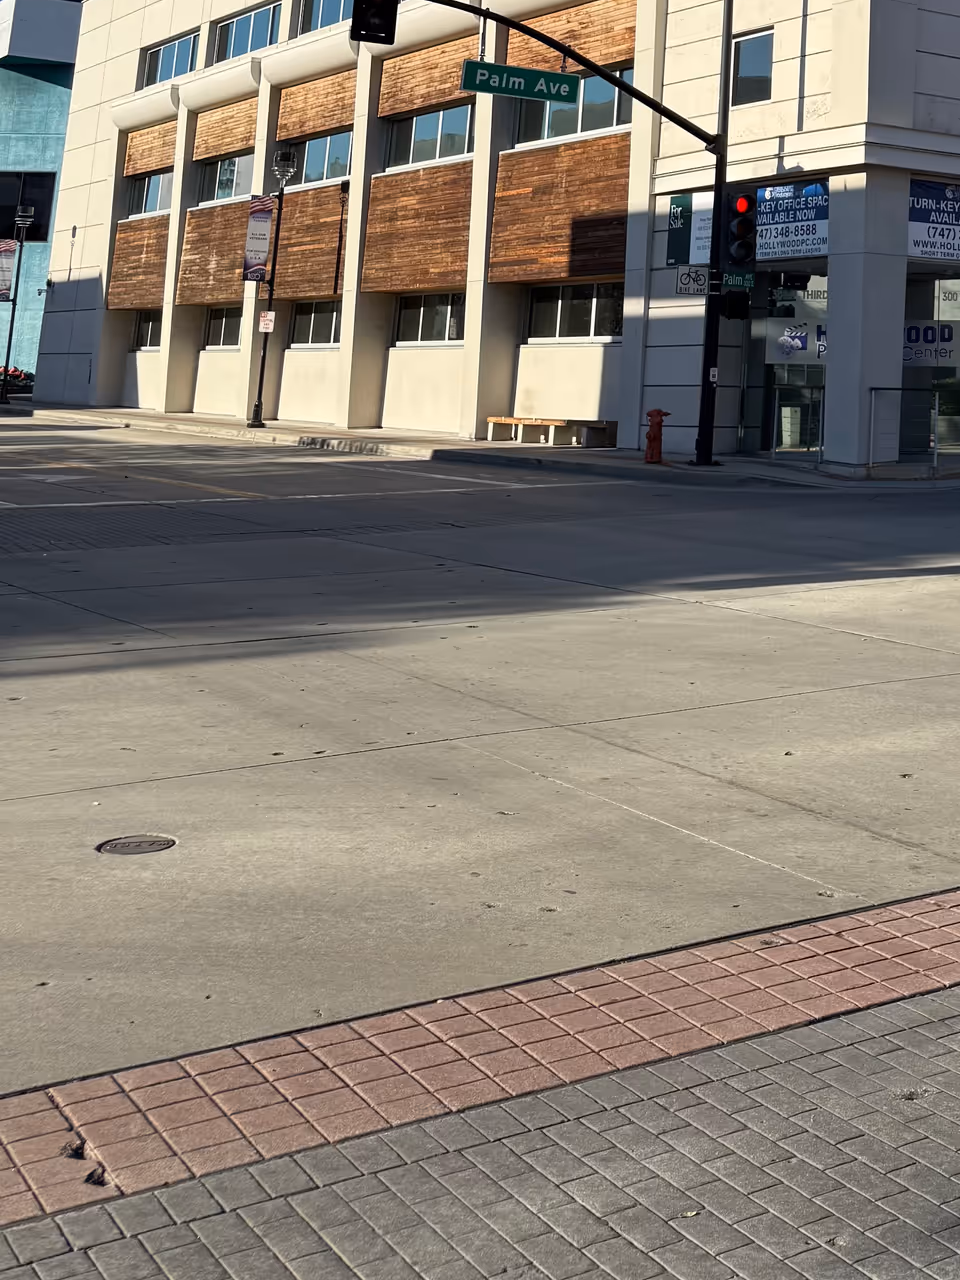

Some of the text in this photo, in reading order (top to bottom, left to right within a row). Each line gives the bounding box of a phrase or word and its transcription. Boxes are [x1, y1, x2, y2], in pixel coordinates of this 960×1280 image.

[475, 69, 570, 96] Palm Ave
[777, 198, 806, 211] OFFICE
[807, 195, 829, 208] SPAC
[909, 197, 960, 212] TURN-KEY
[670, 204, 682, 217] For
[796, 208, 816, 221] NOW
[669, 216, 684, 229] Sale
[773, 223, 817, 239] 348-8588
[927, 225, 956, 241] (747)
[757, 236, 828, 252] .HOLLYWOODPC.COM
[920, 249, 939, 257] SHORT
[723, 273, 743, 286] Palm
[693, 286, 707, 294] LANE
[942, 291, 958, 302] 300
